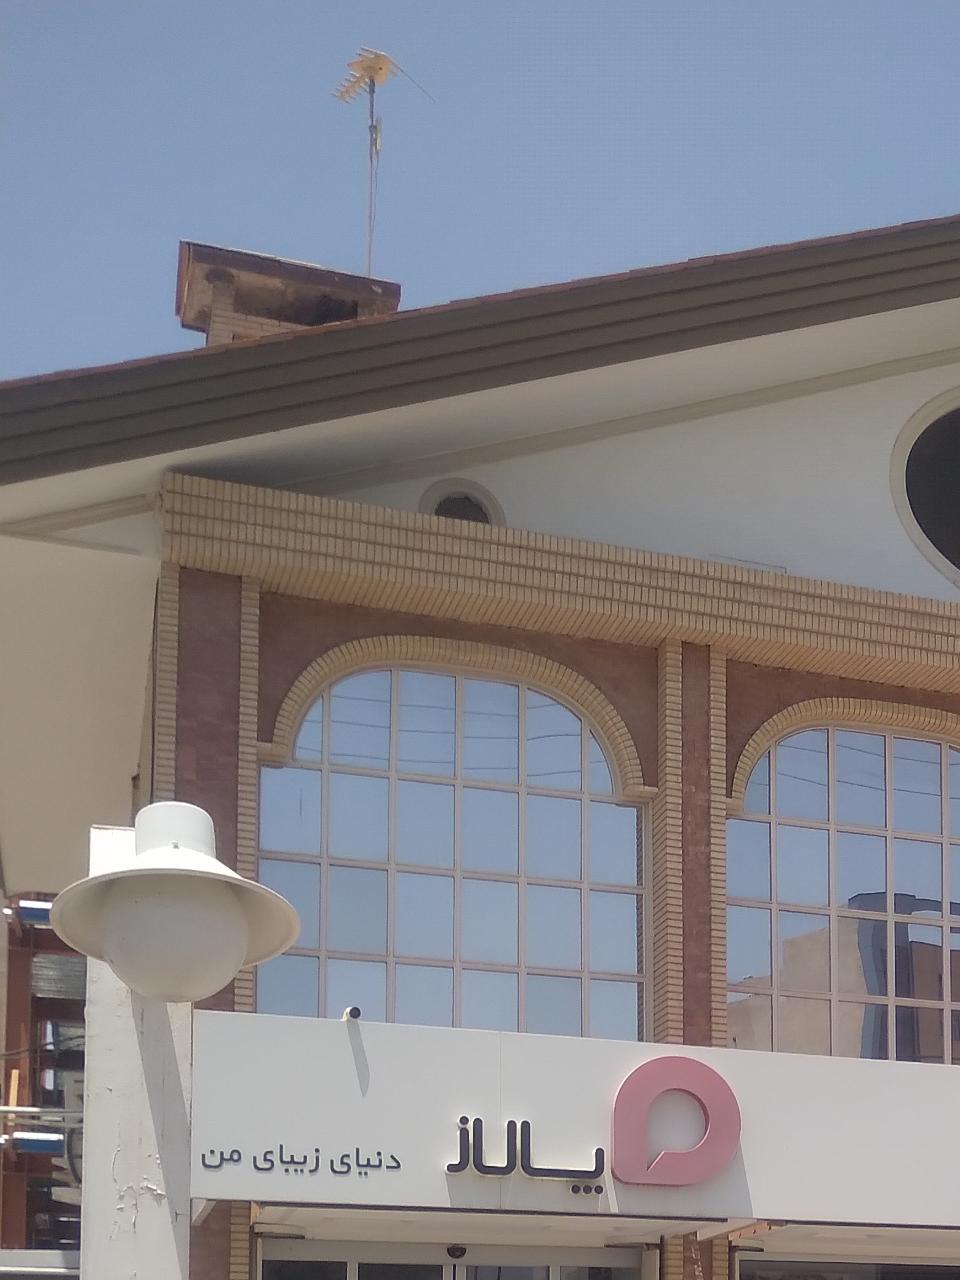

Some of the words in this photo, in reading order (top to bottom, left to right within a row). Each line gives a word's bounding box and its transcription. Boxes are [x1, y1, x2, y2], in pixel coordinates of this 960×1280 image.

[200, 1144, 243, 1170] من
[252, 1143, 321, 1174] زیبای
[329, 1147, 402, 1176] دنیای
[445, 1115, 605, 1195] پالاز
